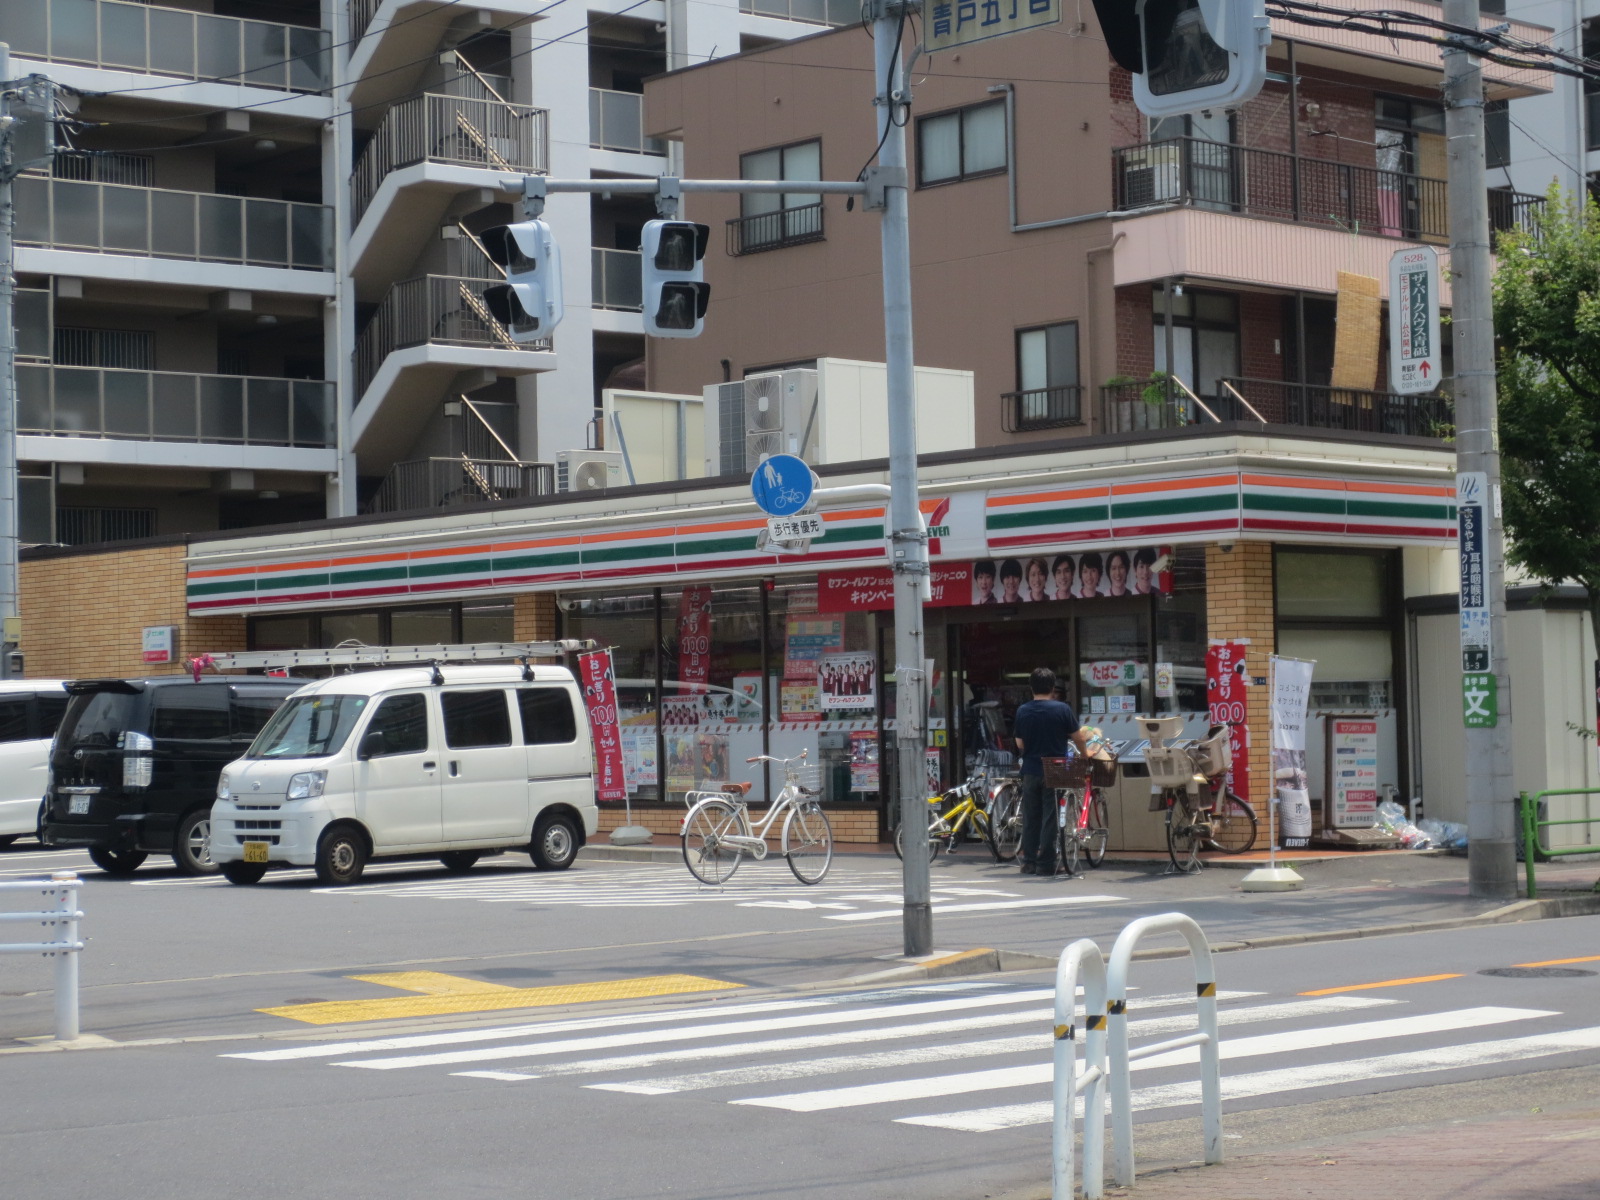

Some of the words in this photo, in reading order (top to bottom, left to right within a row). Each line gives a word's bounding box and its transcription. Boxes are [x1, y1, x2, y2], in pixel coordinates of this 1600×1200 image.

[1401, 275, 1411, 357] モデルルーム公開中
[1411, 272, 1428, 358] ザ・パークハウス青砥
[774, 519, 819, 536] 歩行者優先
[1461, 553, 1469, 606] クリニック
[1471, 552, 1482, 606] 耳鼻咽喉科
[689, 592, 700, 633] おにぎり
[682, 636, 708, 654] 100
[590, 660, 605, 703] おにぎり
[684, 667, 705, 677] セール
[1092, 665, 1119, 680] たばこ
[1124, 664, 1135, 679] 酒
[1218, 648, 1232, 699] おにぎり
[591, 704, 615, 725] 100
[1209, 701, 1245, 724] 100
[1464, 686, 1490, 717] 文
